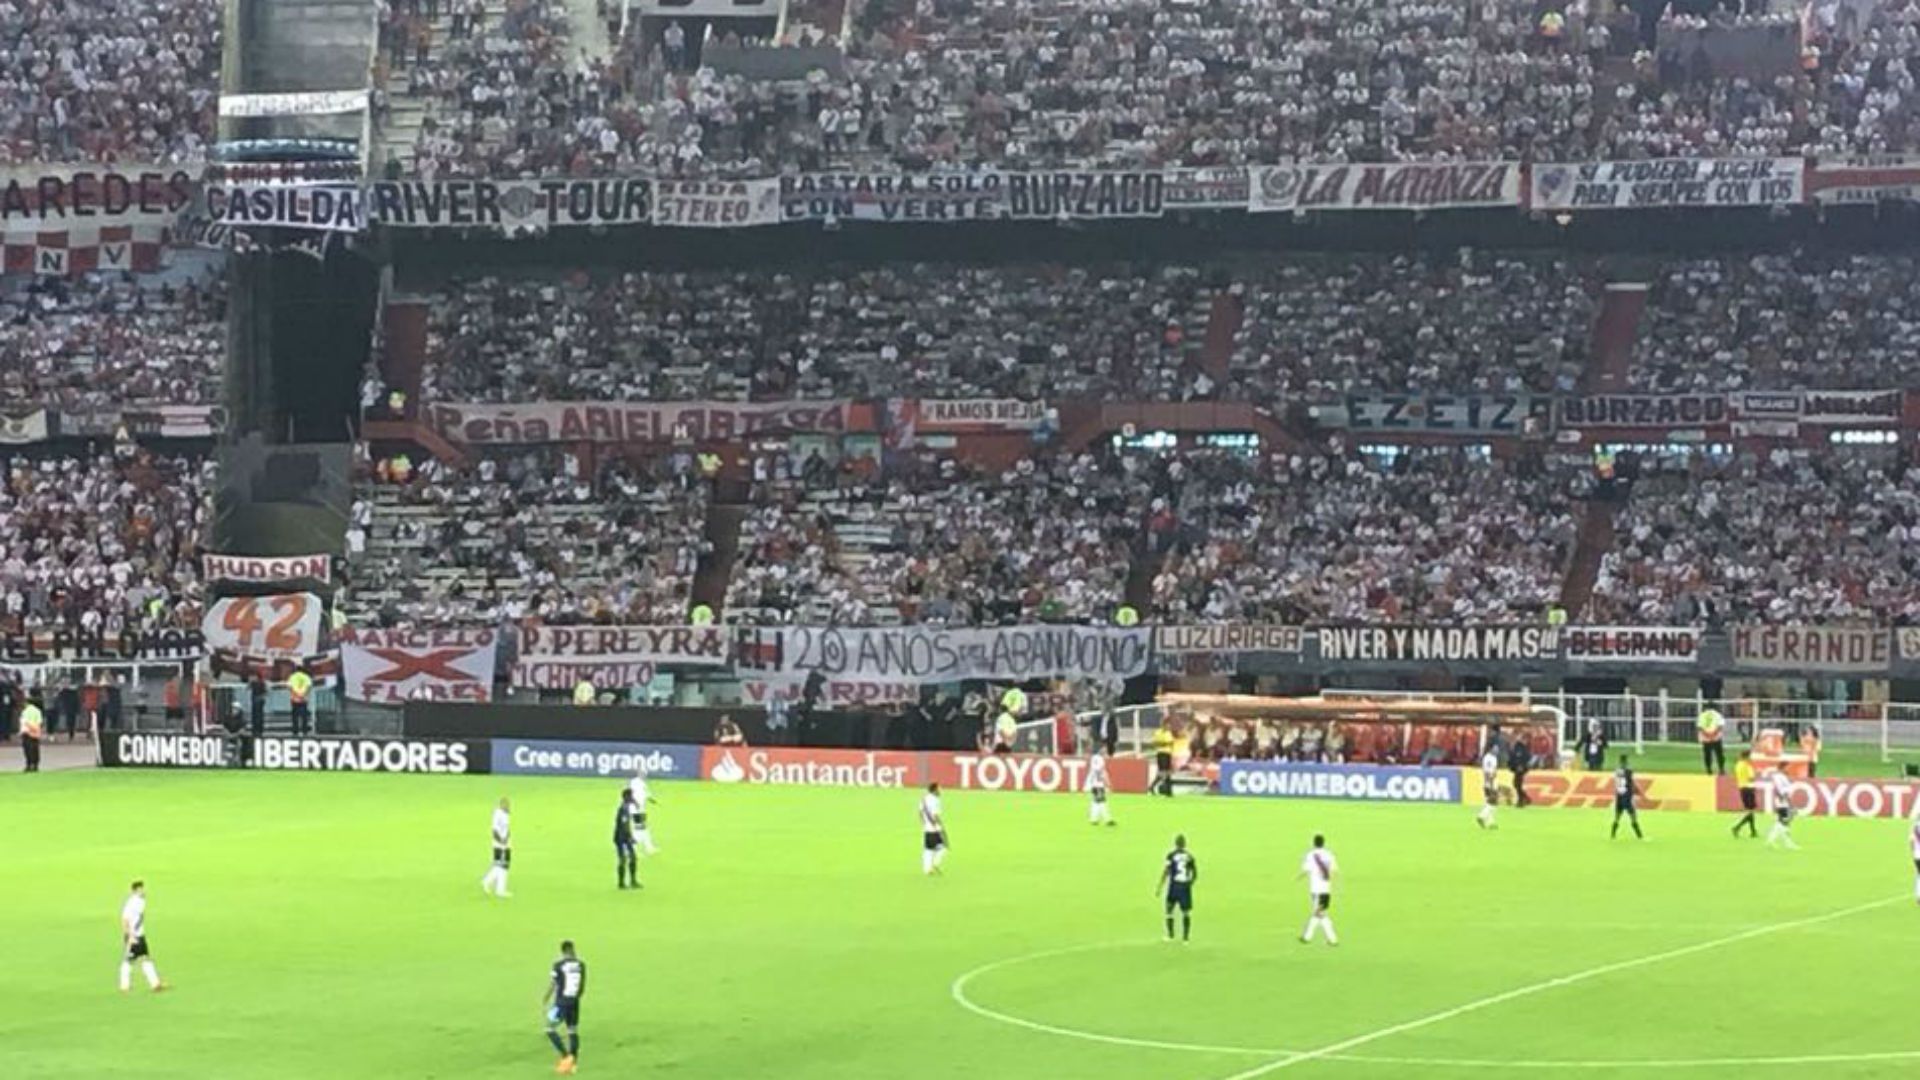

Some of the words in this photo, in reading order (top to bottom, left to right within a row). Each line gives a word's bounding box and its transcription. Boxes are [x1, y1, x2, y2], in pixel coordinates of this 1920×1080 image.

[779, 174, 914, 194] BASTARA
[927, 174, 1000, 193] SOLO
[1008, 173, 1163, 216] BURZACO
[208, 184, 356, 227] CASILDA
[373, 183, 501, 223] RIVER
[540, 179, 651, 221] TOUR
[658, 200, 749, 222] STEREO
[784, 198, 854, 217] CON
[879, 199, 1000, 218] VERTE
[41, 251, 62, 271] N
[104, 244, 125, 264] V
[559, 406, 673, 440] ARIEL
[935, 402, 994, 420] RAMOS
[206, 556, 327, 579] HUDSON
[223, 593, 306, 649] 42
[521, 627, 722, 657] P.PEREYRA
[1160, 625, 1299, 649] LUZURIAGA
[1319, 628, 1388, 659] RIVER
[1392, 628, 1408, 659] Y
[1413, 628, 1479, 659] NADA
[1571, 631, 1694, 656] BELGRANO
[1736, 628, 1887, 663] M.GRANDE
[857, 633, 958, 676] AÑOS
[991, 629, 1140, 674] ABANDONO
[773, 681, 920, 702] JRDIN
[118, 734, 228, 766] CONMEBOL
[245, 736, 468, 772] IBERTADORES
[514, 745, 562, 768] Cree
[566, 752, 593, 769] en
[748, 752, 908, 788] Santander
[1231, 771, 1449, 799] CONMEBOL.COM
[1521, 775, 1662, 809] DHL
